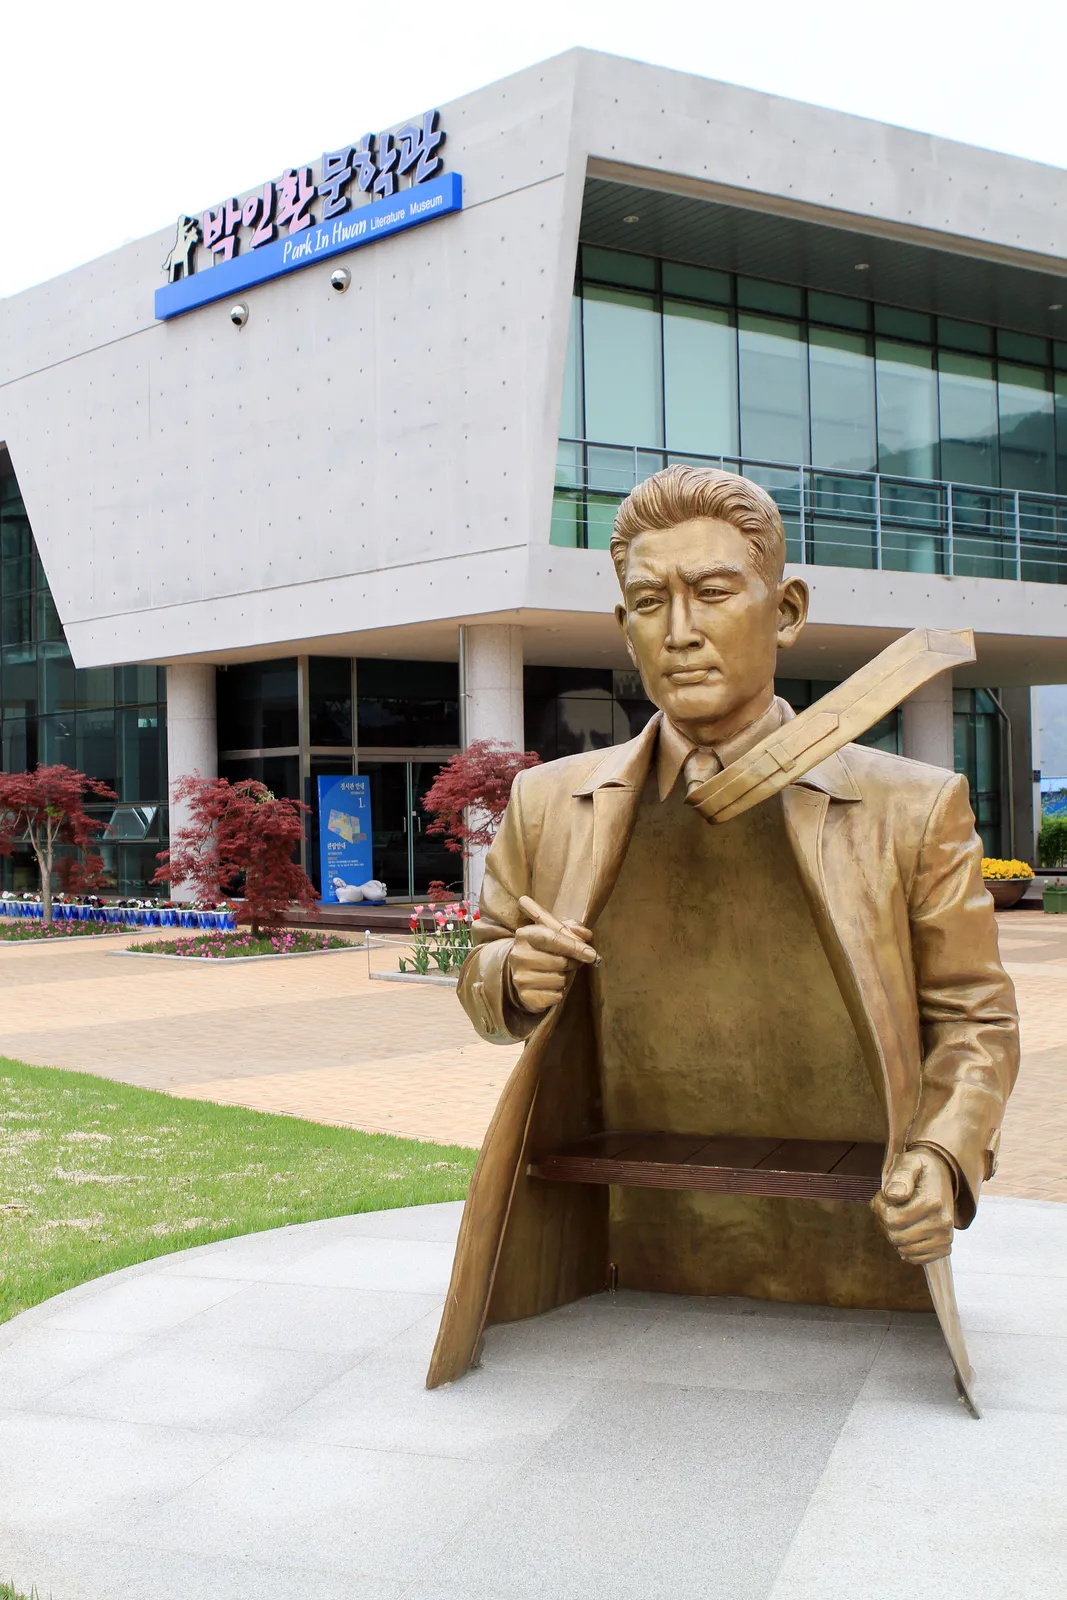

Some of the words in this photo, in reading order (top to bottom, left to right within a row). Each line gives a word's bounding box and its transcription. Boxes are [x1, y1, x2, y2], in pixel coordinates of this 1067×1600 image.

[283, 233, 312, 264] Park
[314, 228, 329, 252] In
[332, 218, 367, 244] Hwan
[370, 208, 405, 230] Literature
[410, 193, 443, 216] Museum
